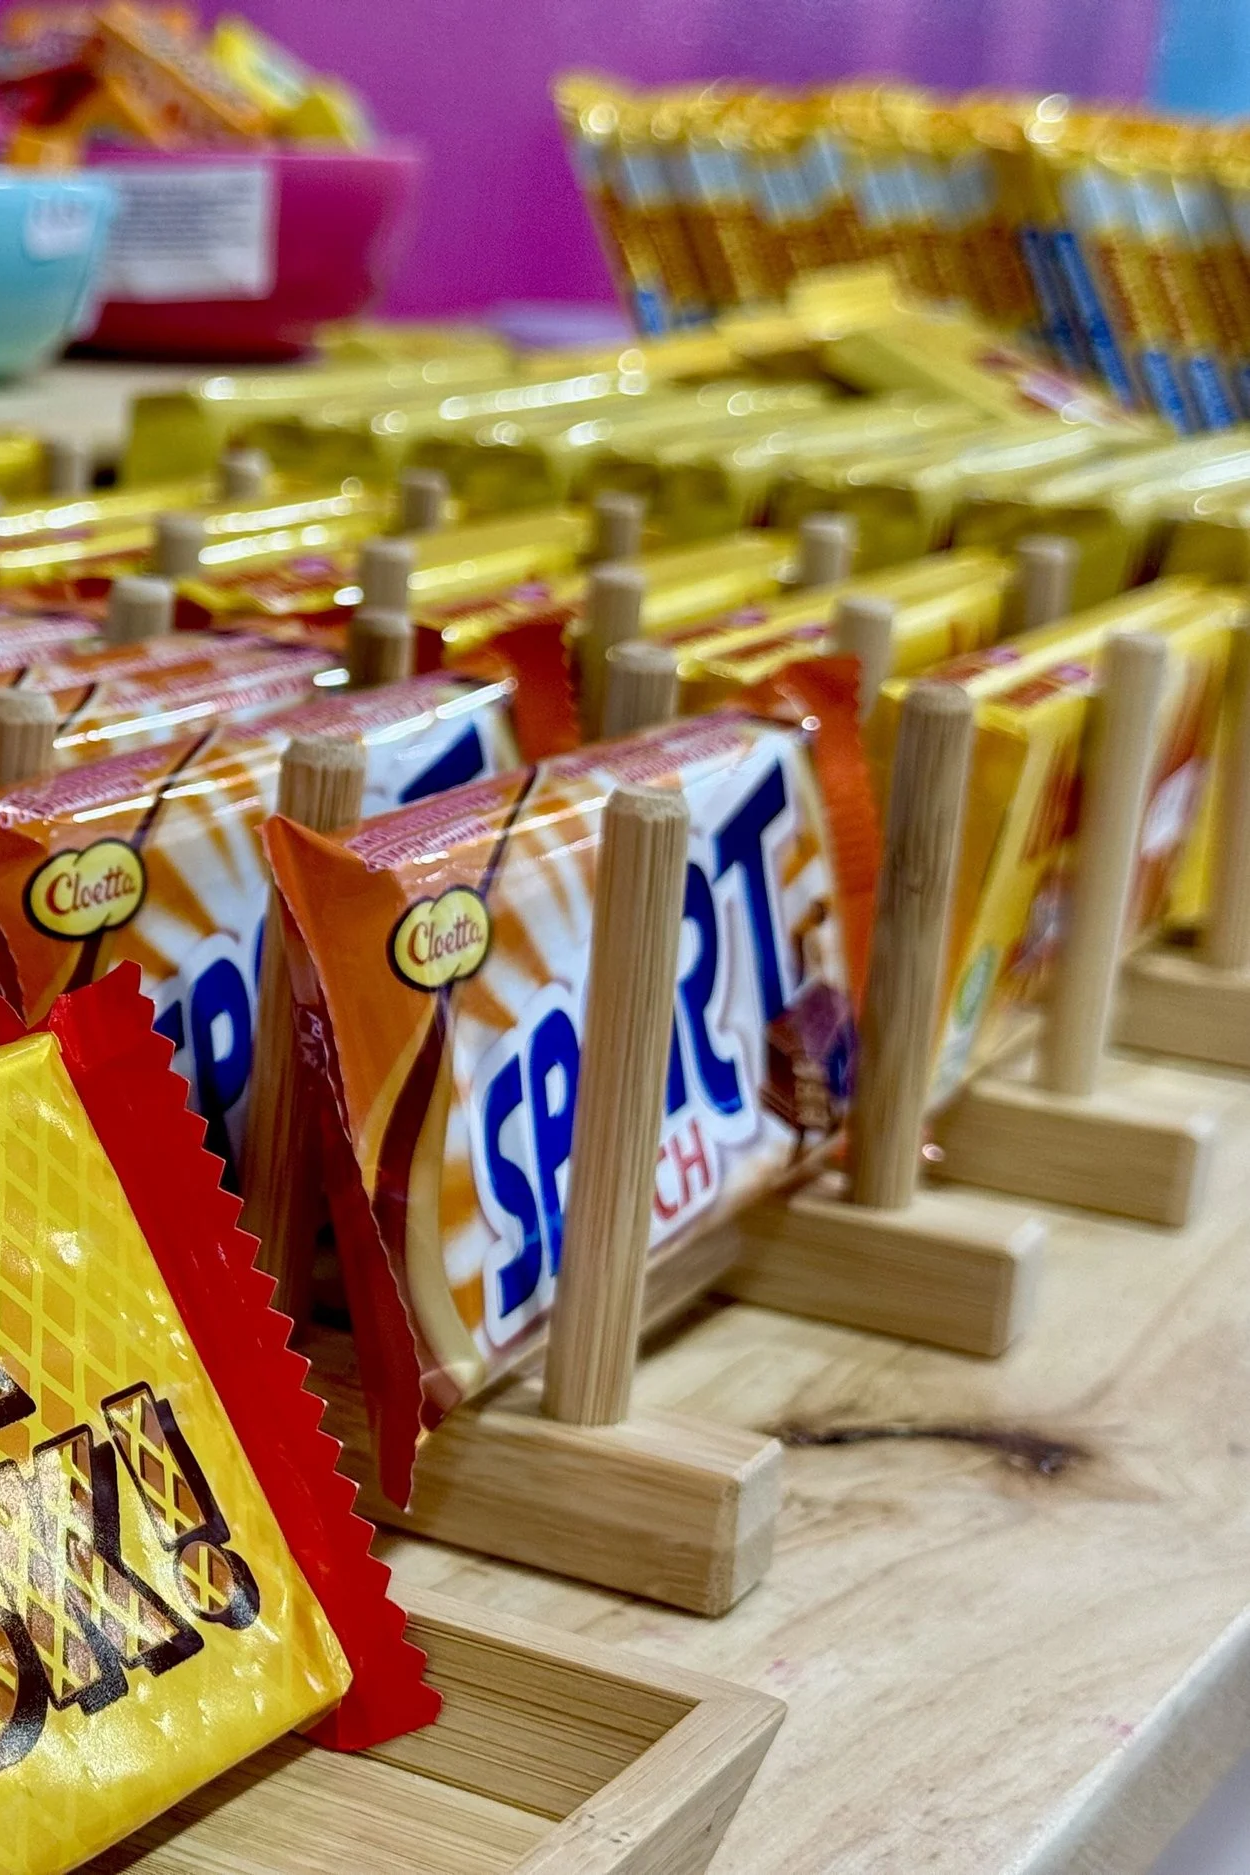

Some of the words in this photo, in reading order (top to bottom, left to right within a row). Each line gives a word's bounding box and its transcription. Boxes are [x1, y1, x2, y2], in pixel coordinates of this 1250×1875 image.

[46, 864, 136, 917] Cloetta
[407, 914, 483, 967] Cloetta
[483, 759, 787, 1318] SPRT
